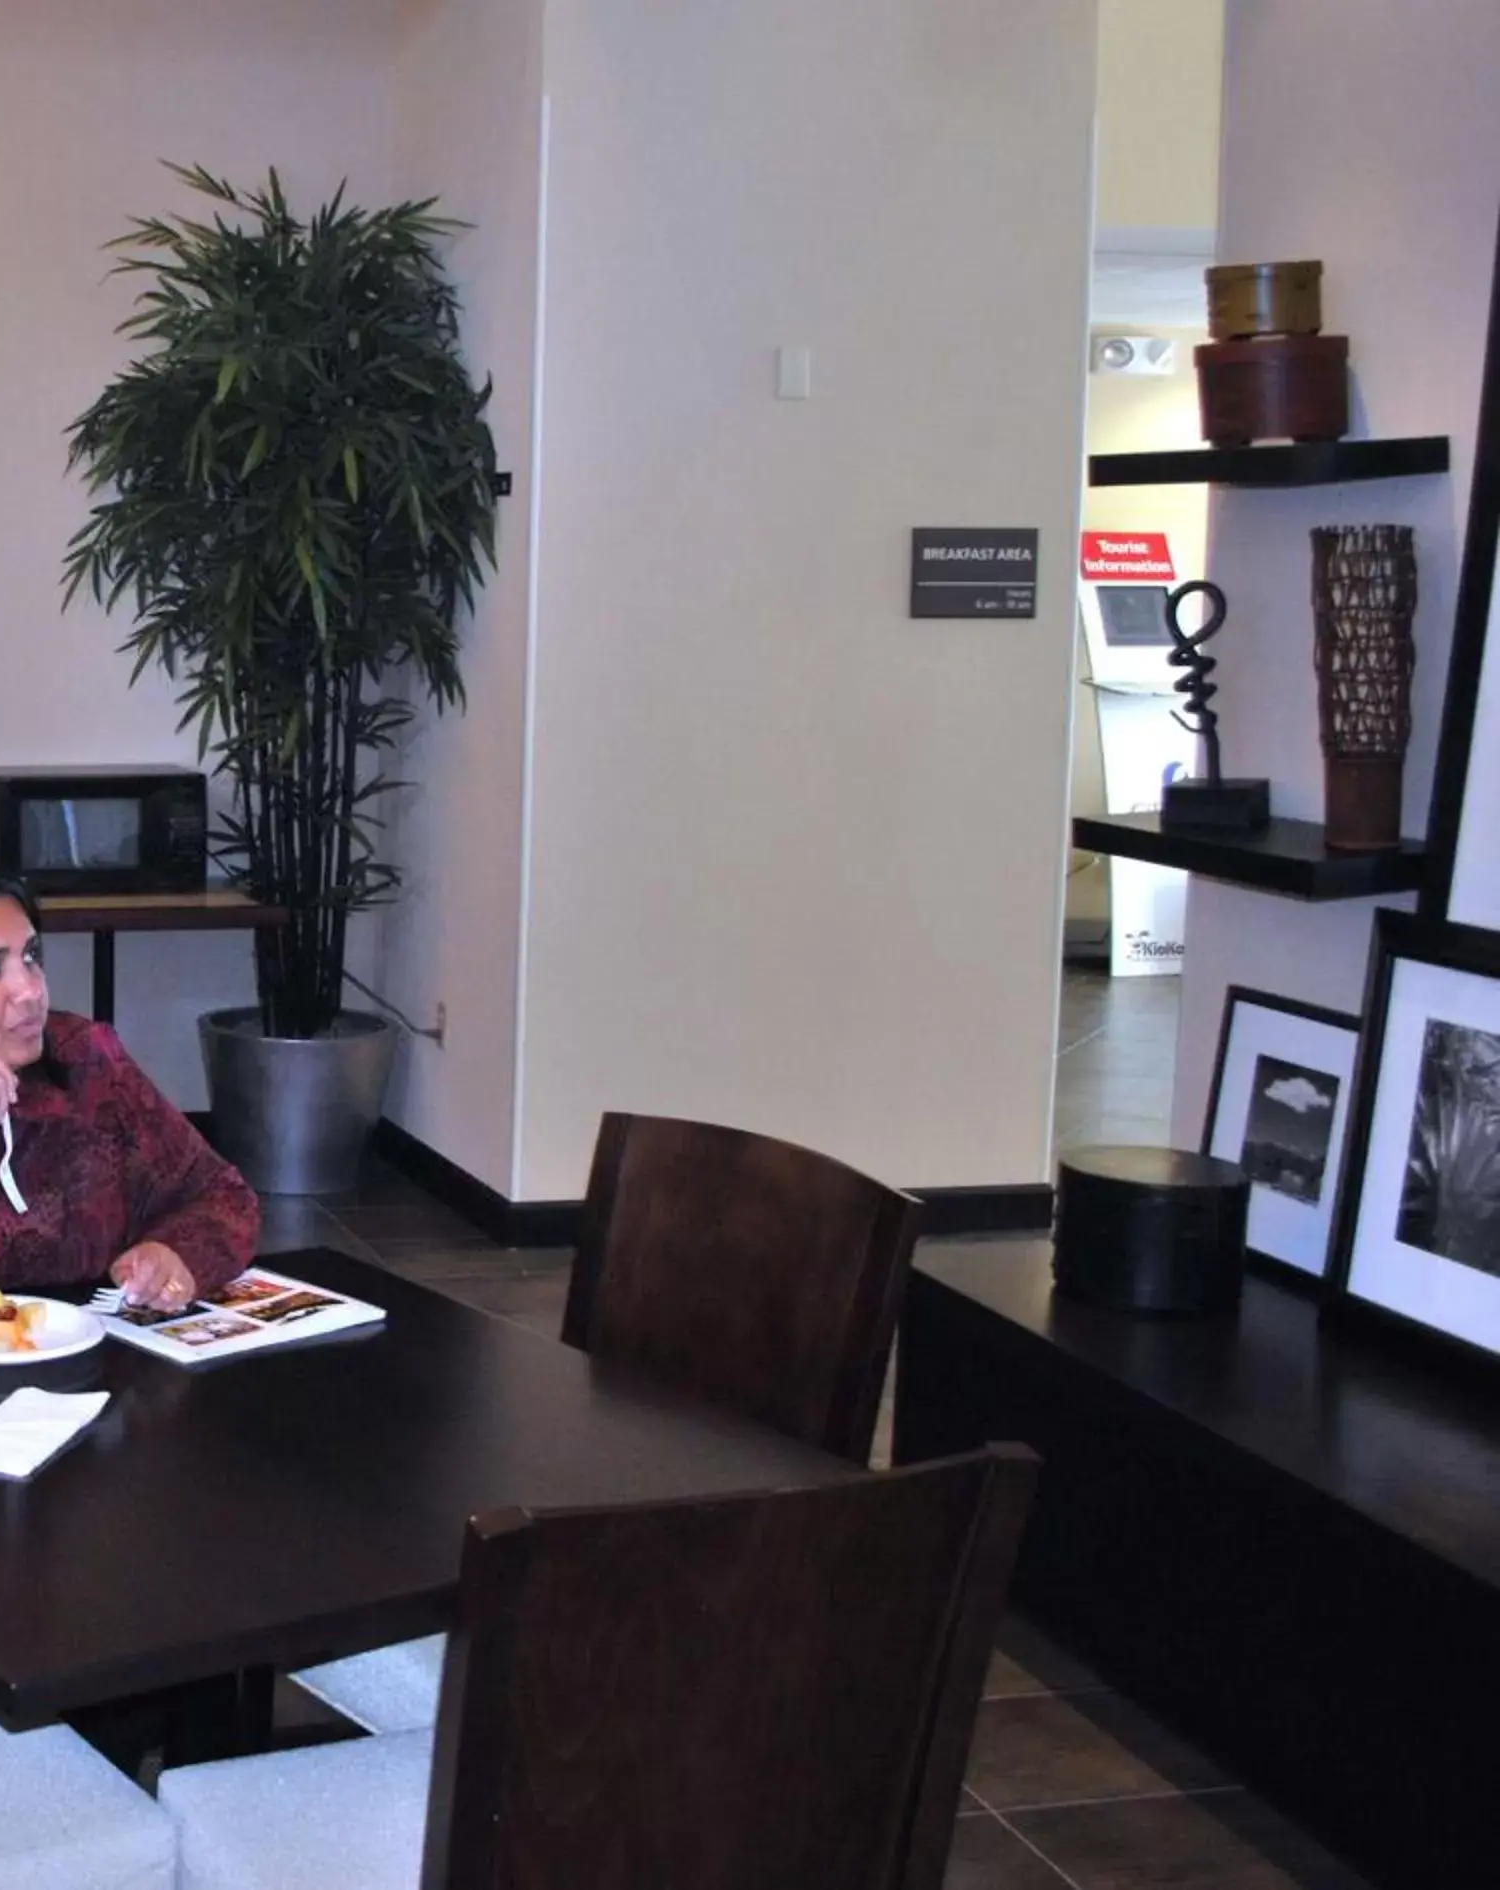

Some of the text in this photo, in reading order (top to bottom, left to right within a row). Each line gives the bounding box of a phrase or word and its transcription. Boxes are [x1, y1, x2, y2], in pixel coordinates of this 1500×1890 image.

[922, 547, 1032, 561] BREAKFAST AREA
[1096, 539, 1149, 555] Tourist
